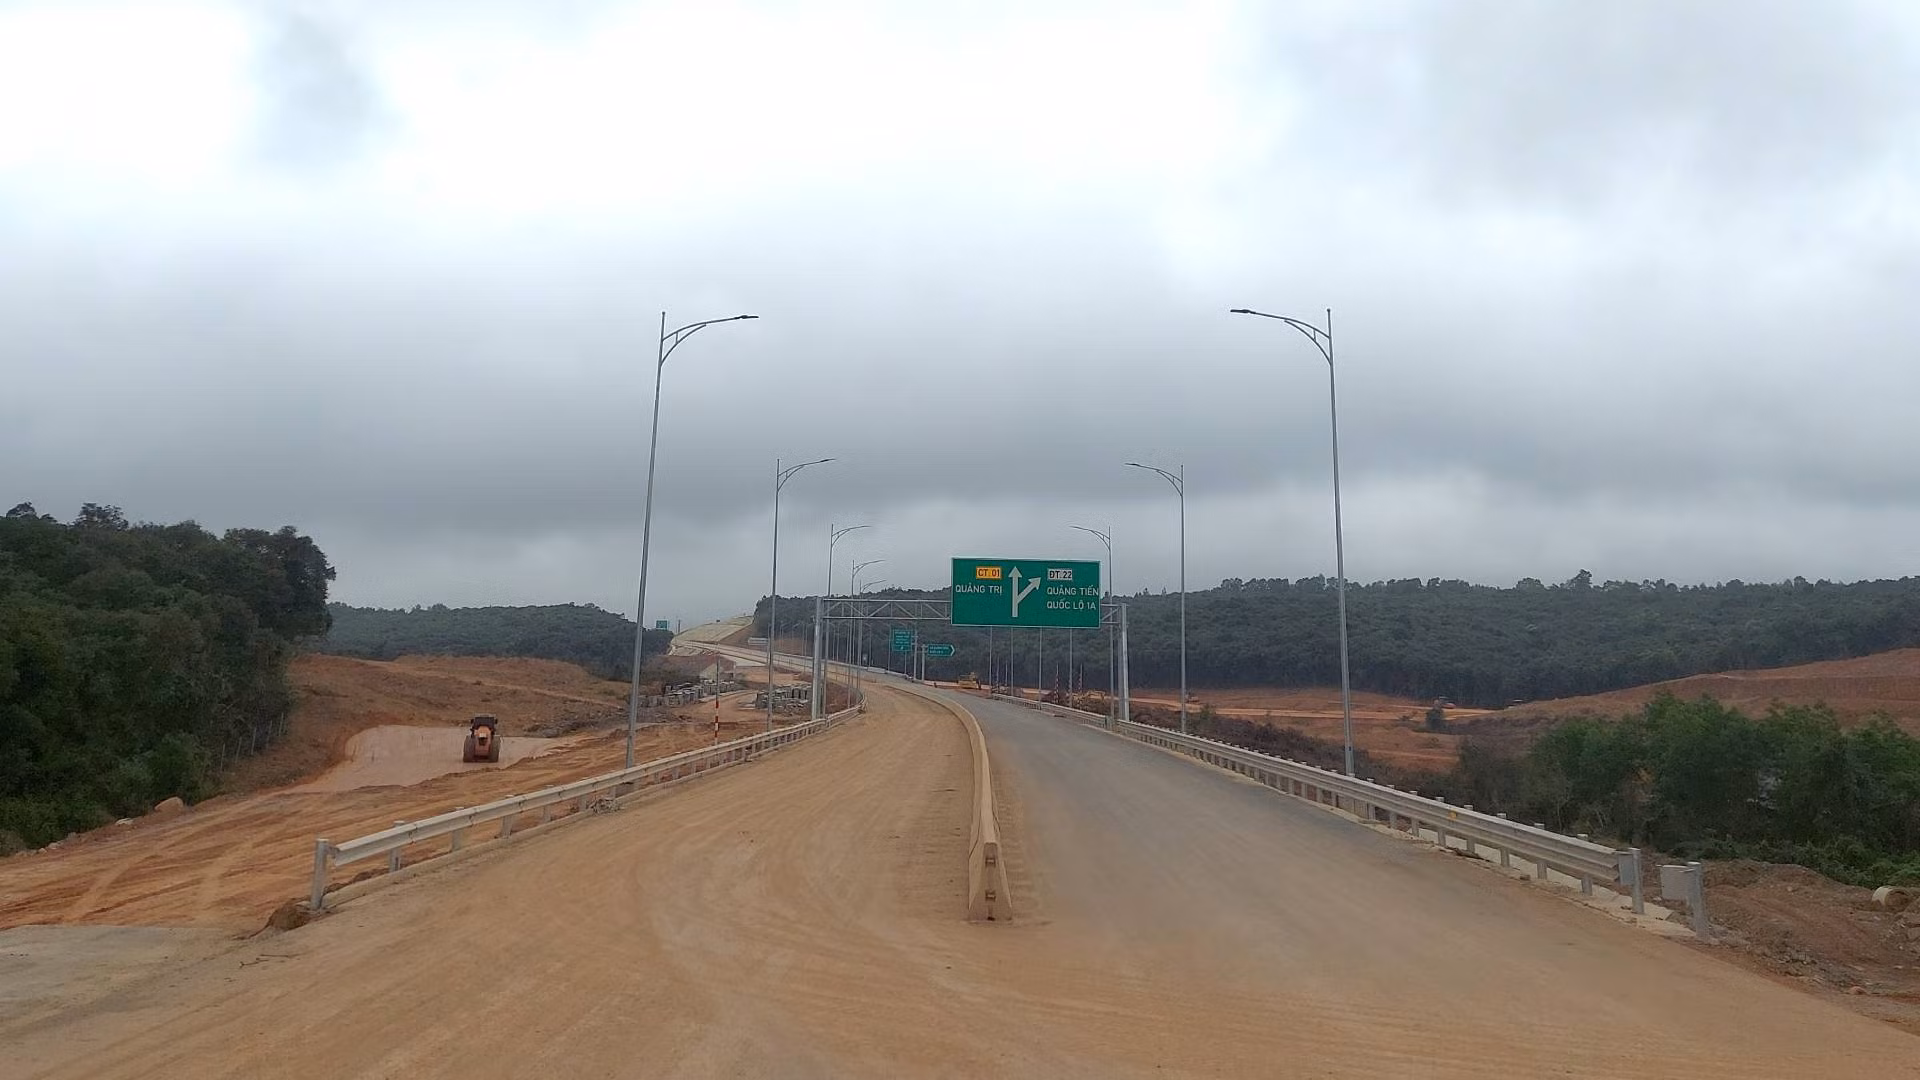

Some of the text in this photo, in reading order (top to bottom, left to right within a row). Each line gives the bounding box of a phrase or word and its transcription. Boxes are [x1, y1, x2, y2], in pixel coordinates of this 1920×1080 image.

[955, 582, 1003, 596] QUẢNG TRỊ
[1047, 584, 1099, 596] QUẢNG TIẾN
[1047, 597, 1096, 612] QUỐC LỘ 1A
